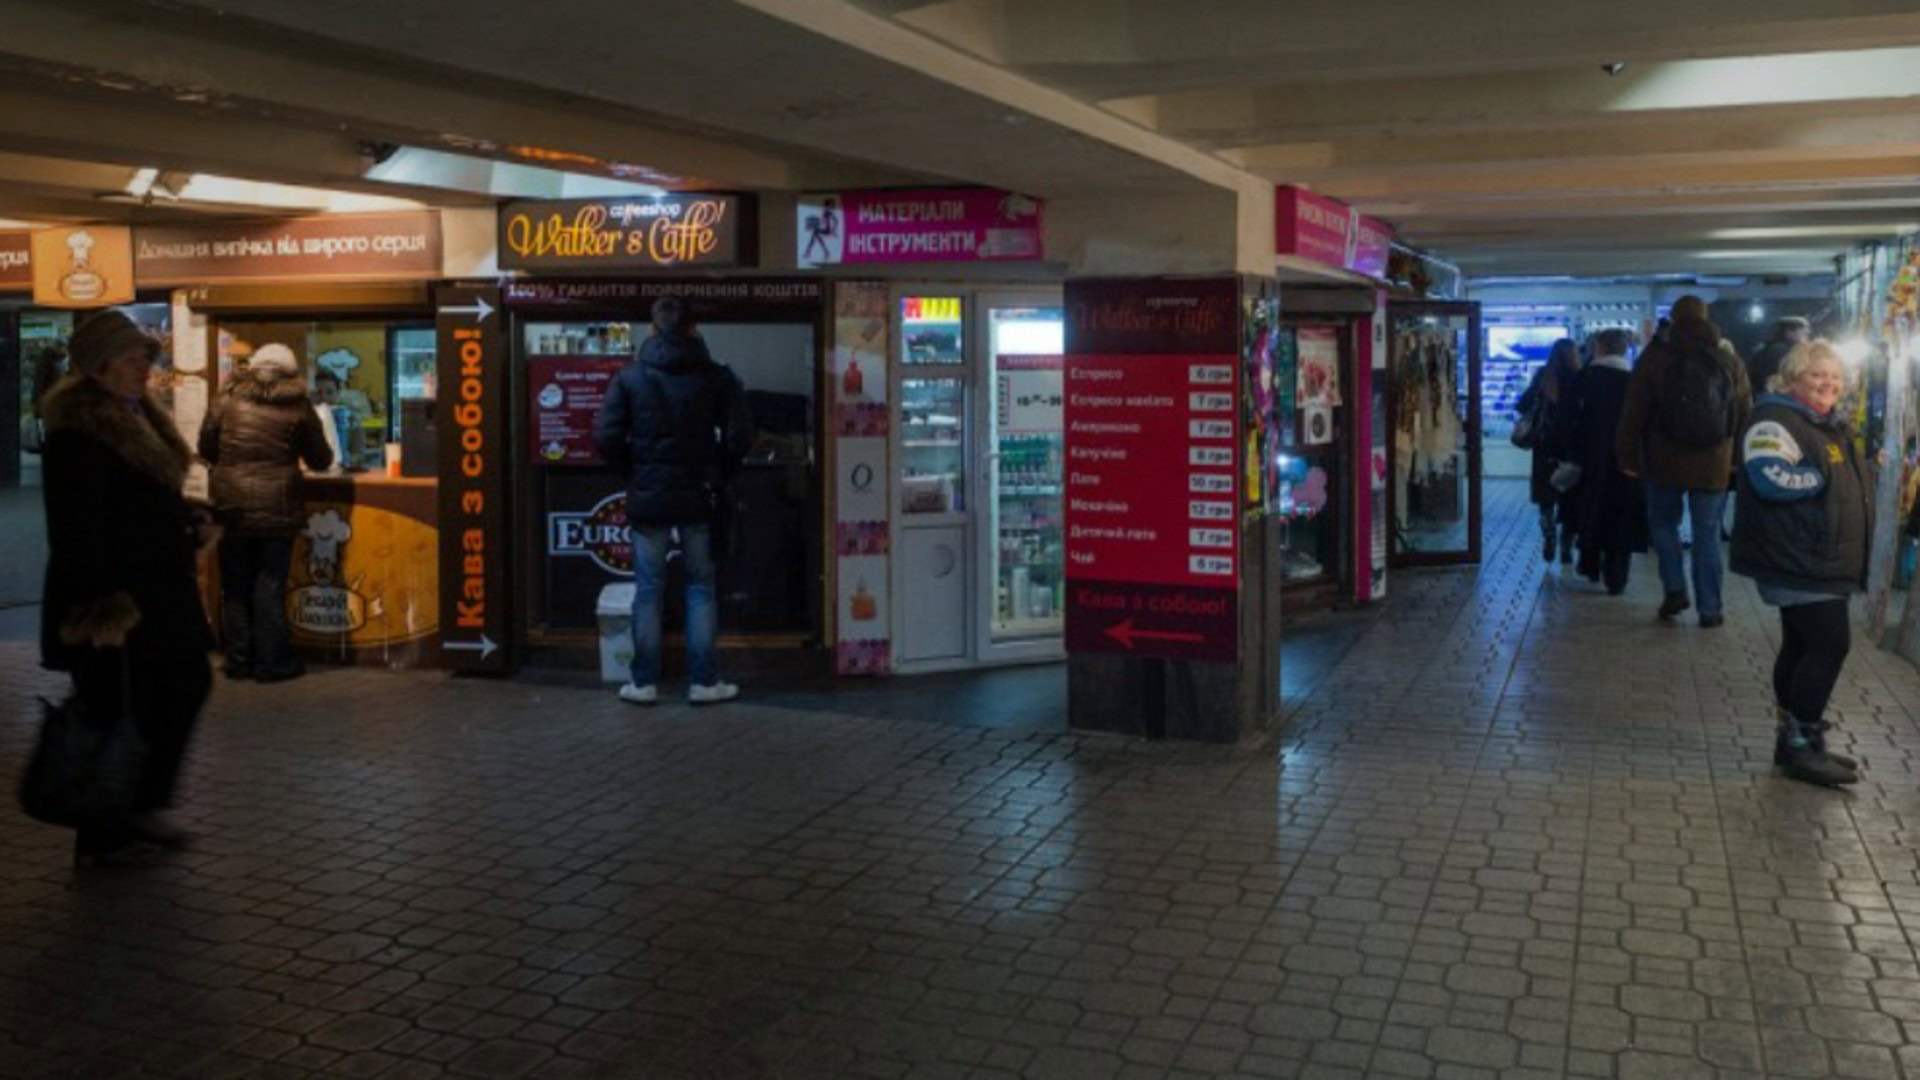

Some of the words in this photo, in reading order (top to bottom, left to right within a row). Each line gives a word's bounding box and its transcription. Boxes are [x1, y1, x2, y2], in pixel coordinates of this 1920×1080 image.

[858, 201, 967, 222] МАТЕРІАЛИ
[850, 231, 976, 254] ІНСТРУМЕНТИ
[557, 284, 638, 297] ГАРАНТІЯ
[641, 284, 748, 297] ПОВЕРНЕННЯ
[753, 283, 818, 297] КОШТІВ
[454, 328, 485, 477] собою!
[457, 528, 485, 627] Кава
